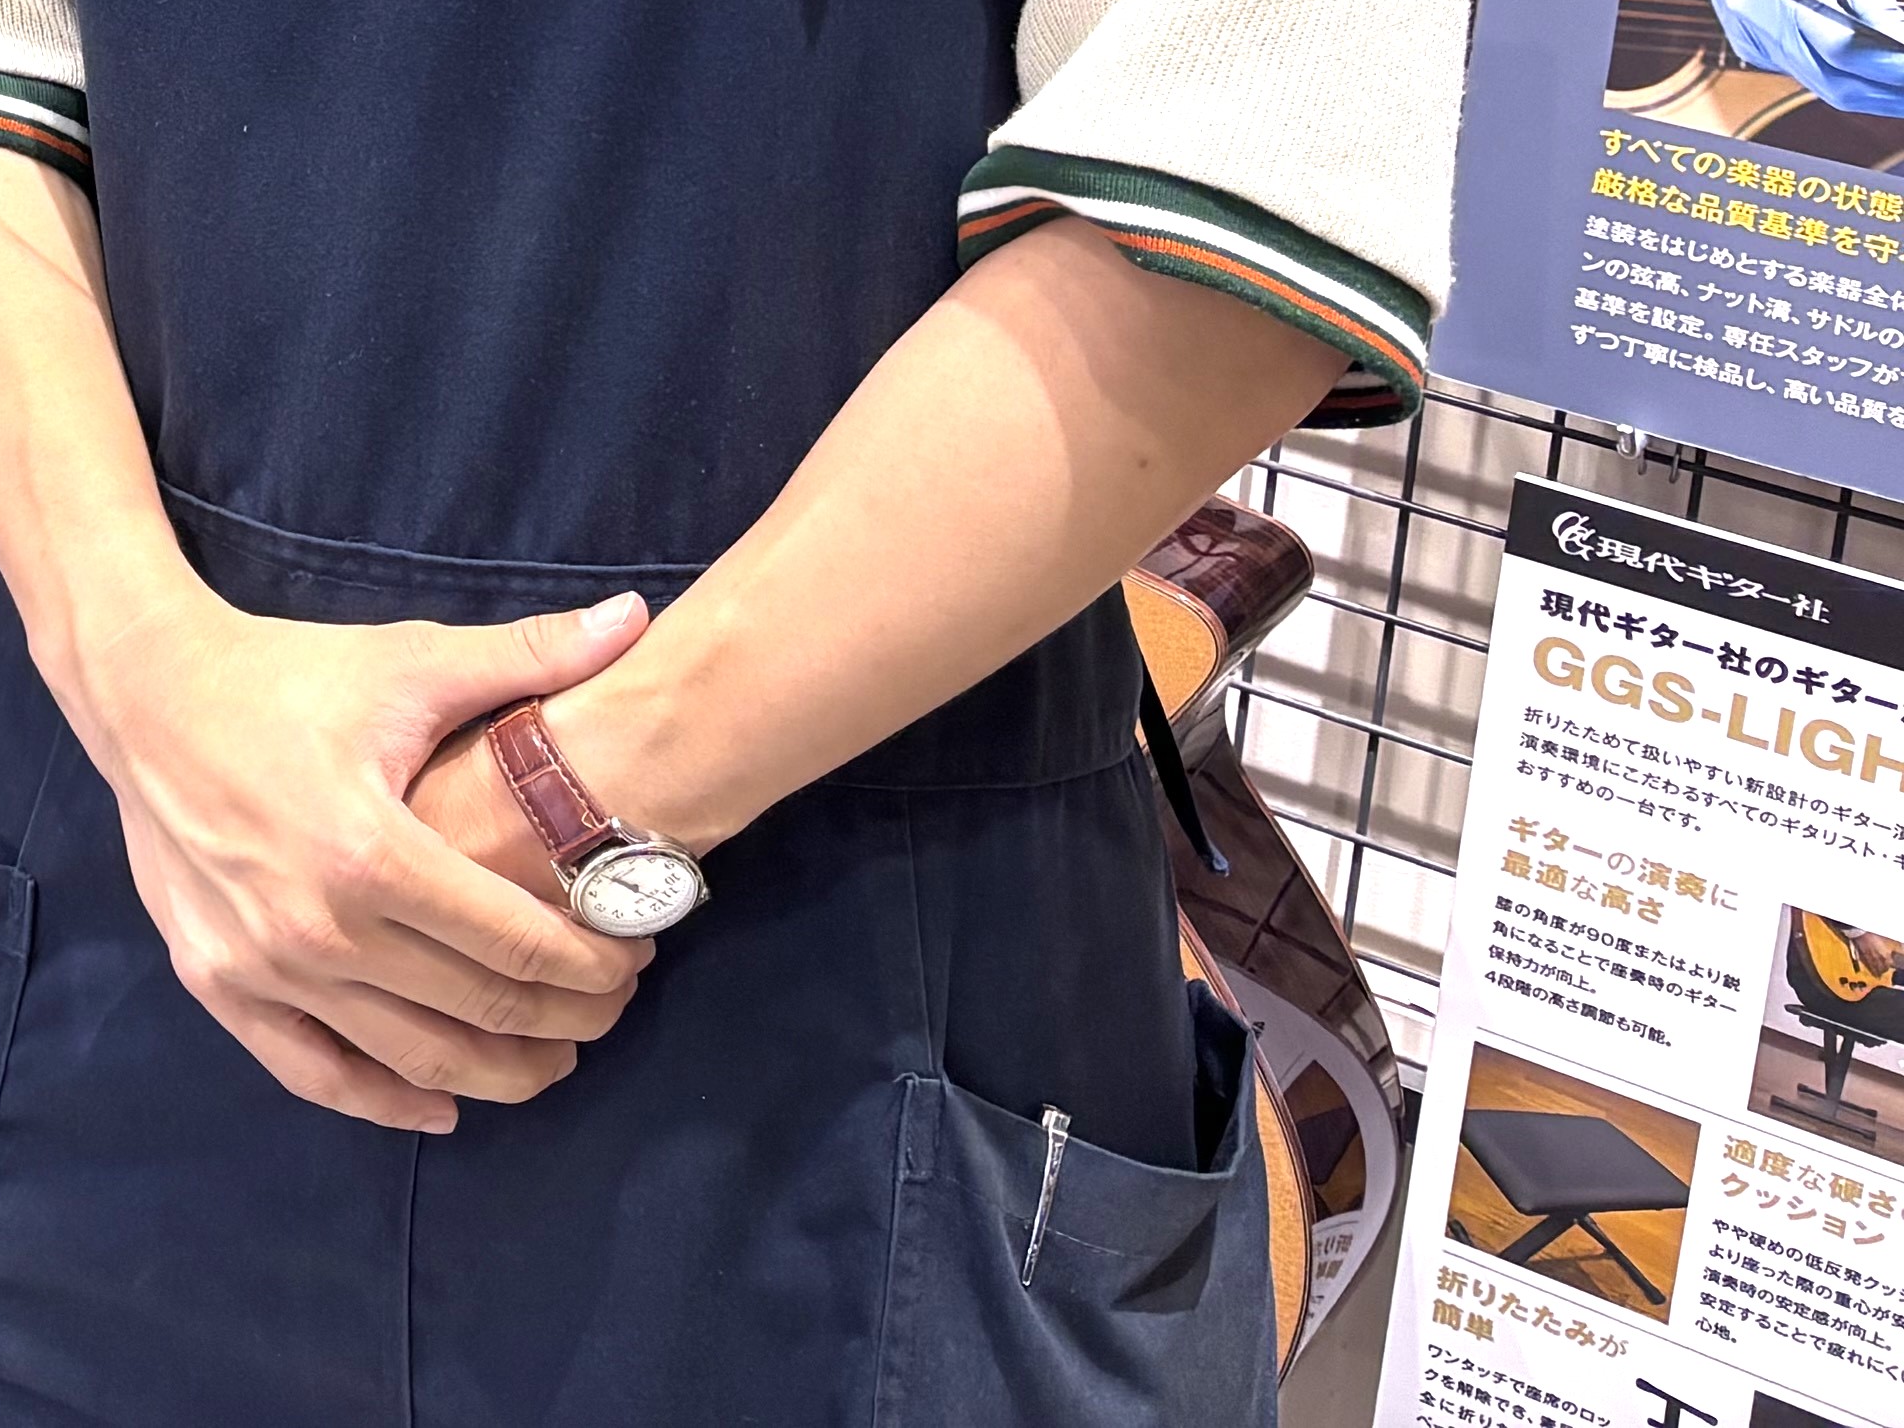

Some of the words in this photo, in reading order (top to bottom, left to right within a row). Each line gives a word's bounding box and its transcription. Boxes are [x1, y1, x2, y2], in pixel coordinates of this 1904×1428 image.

[1590, 166, 1904, 264] 厳格な品質基準を守
[1573, 286, 1904, 386] 基準を設定。専任スタッフが
[1596, 536, 1832, 626] 現代ギター社
[1541, 588, 1904, 726] 現代ギター社のギター
[1516, 758, 1703, 832] おすすめの一台です。
[1499, 849, 1667, 926] 最適な高さ
[1507, 815, 1740, 912] ギターの演奏に
[1484, 970, 1672, 1048] 4段階の高さ調節も可能。
[1488, 943, 1597, 994] 保持力が向上。
[1720, 1172, 1885, 1246] クッション
[1722, 1134, 1904, 1221] 適度な硬さ
[1430, 1297, 1496, 1344] 簡単
[1435, 1264, 1629, 1359] 折りたたみが
[1694, 1316, 1738, 1344] 心地。
[1699, 1290, 1904, 1384] 安定することで疲れにく
[1702, 1265, 1893, 1352] 演奏時の安定感が向上。
[1427, 1343, 1612, 1428] ワンタッチで座席のロッ
